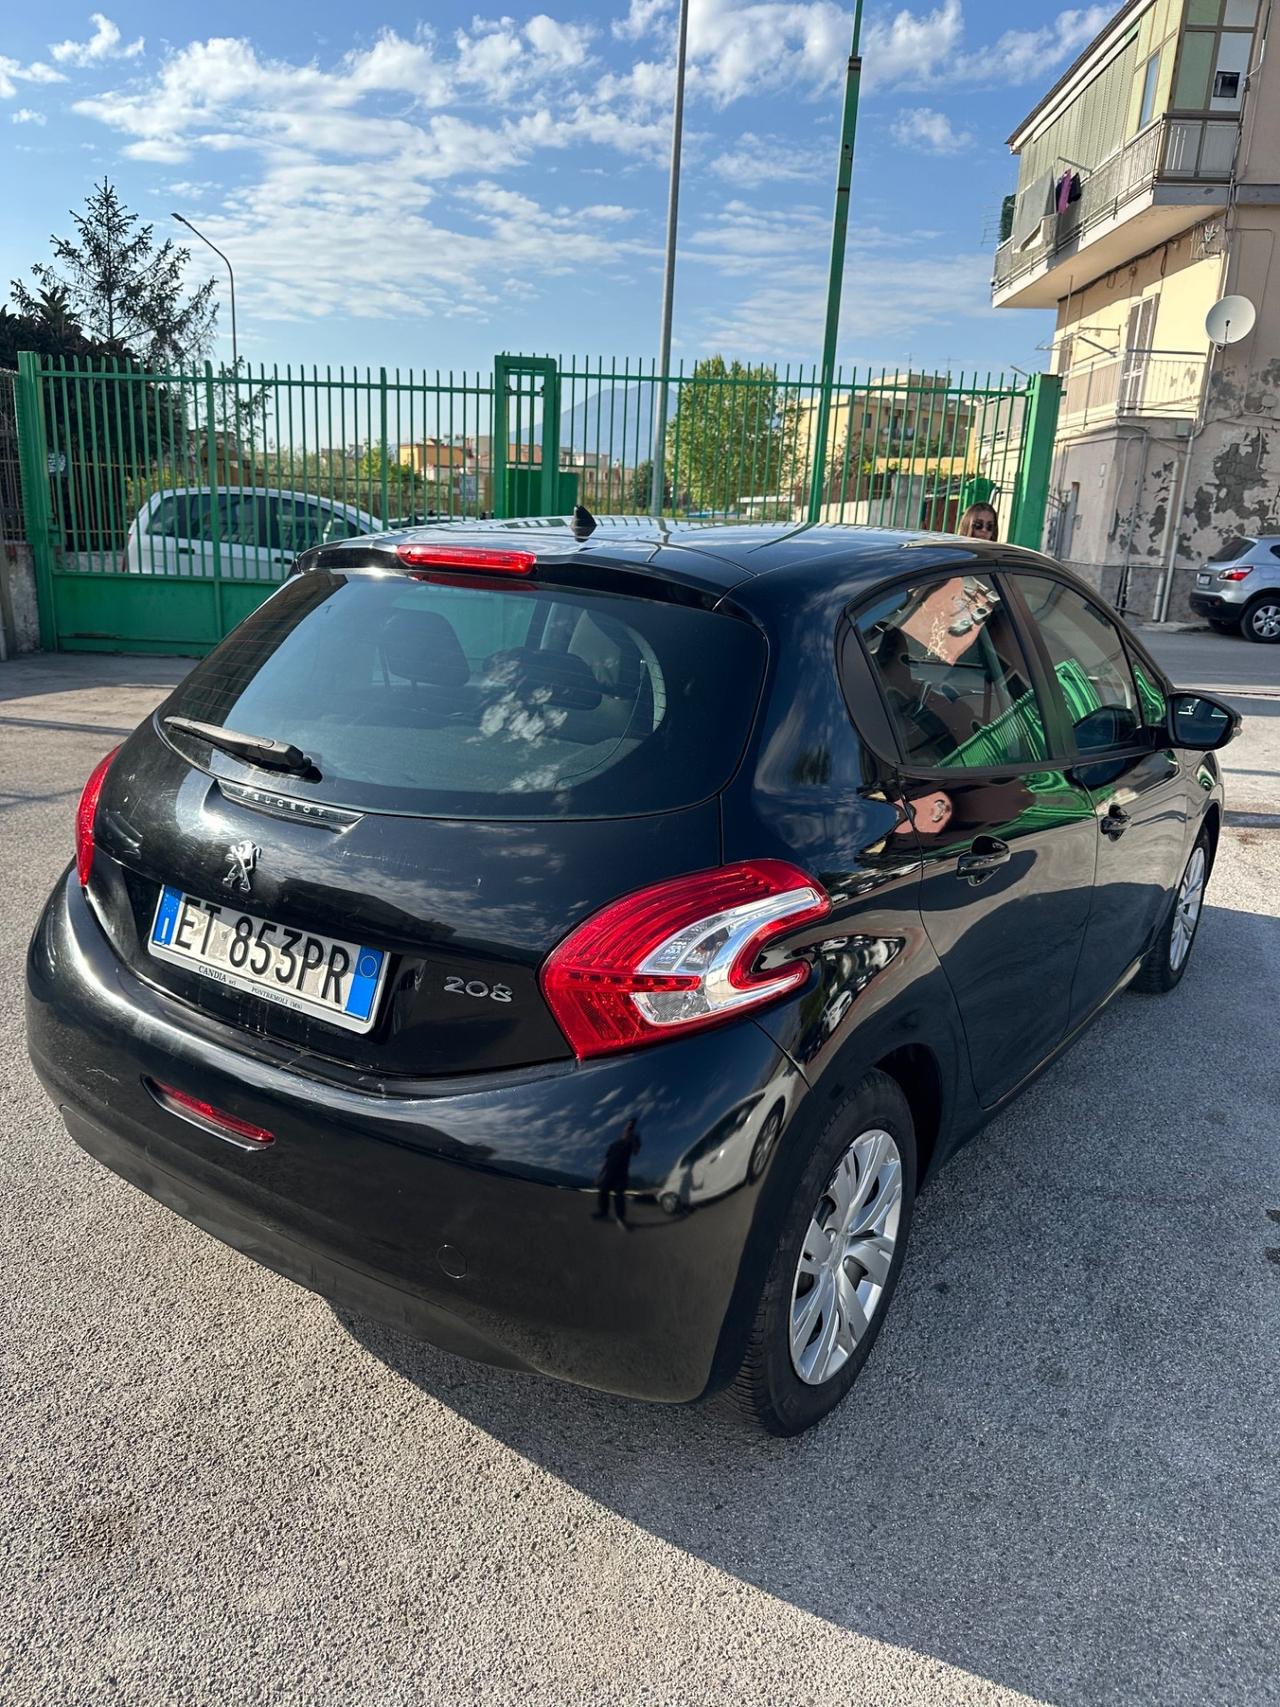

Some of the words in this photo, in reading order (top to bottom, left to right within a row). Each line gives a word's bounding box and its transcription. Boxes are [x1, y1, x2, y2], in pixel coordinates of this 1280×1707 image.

[241, 790, 325, 817] PEUGEOT
[175, 896, 222, 956] ET
[229, 916, 351, 1005] 853PR
[198, 965, 227, 982] CANDIA
[443, 976, 513, 1003] 208
